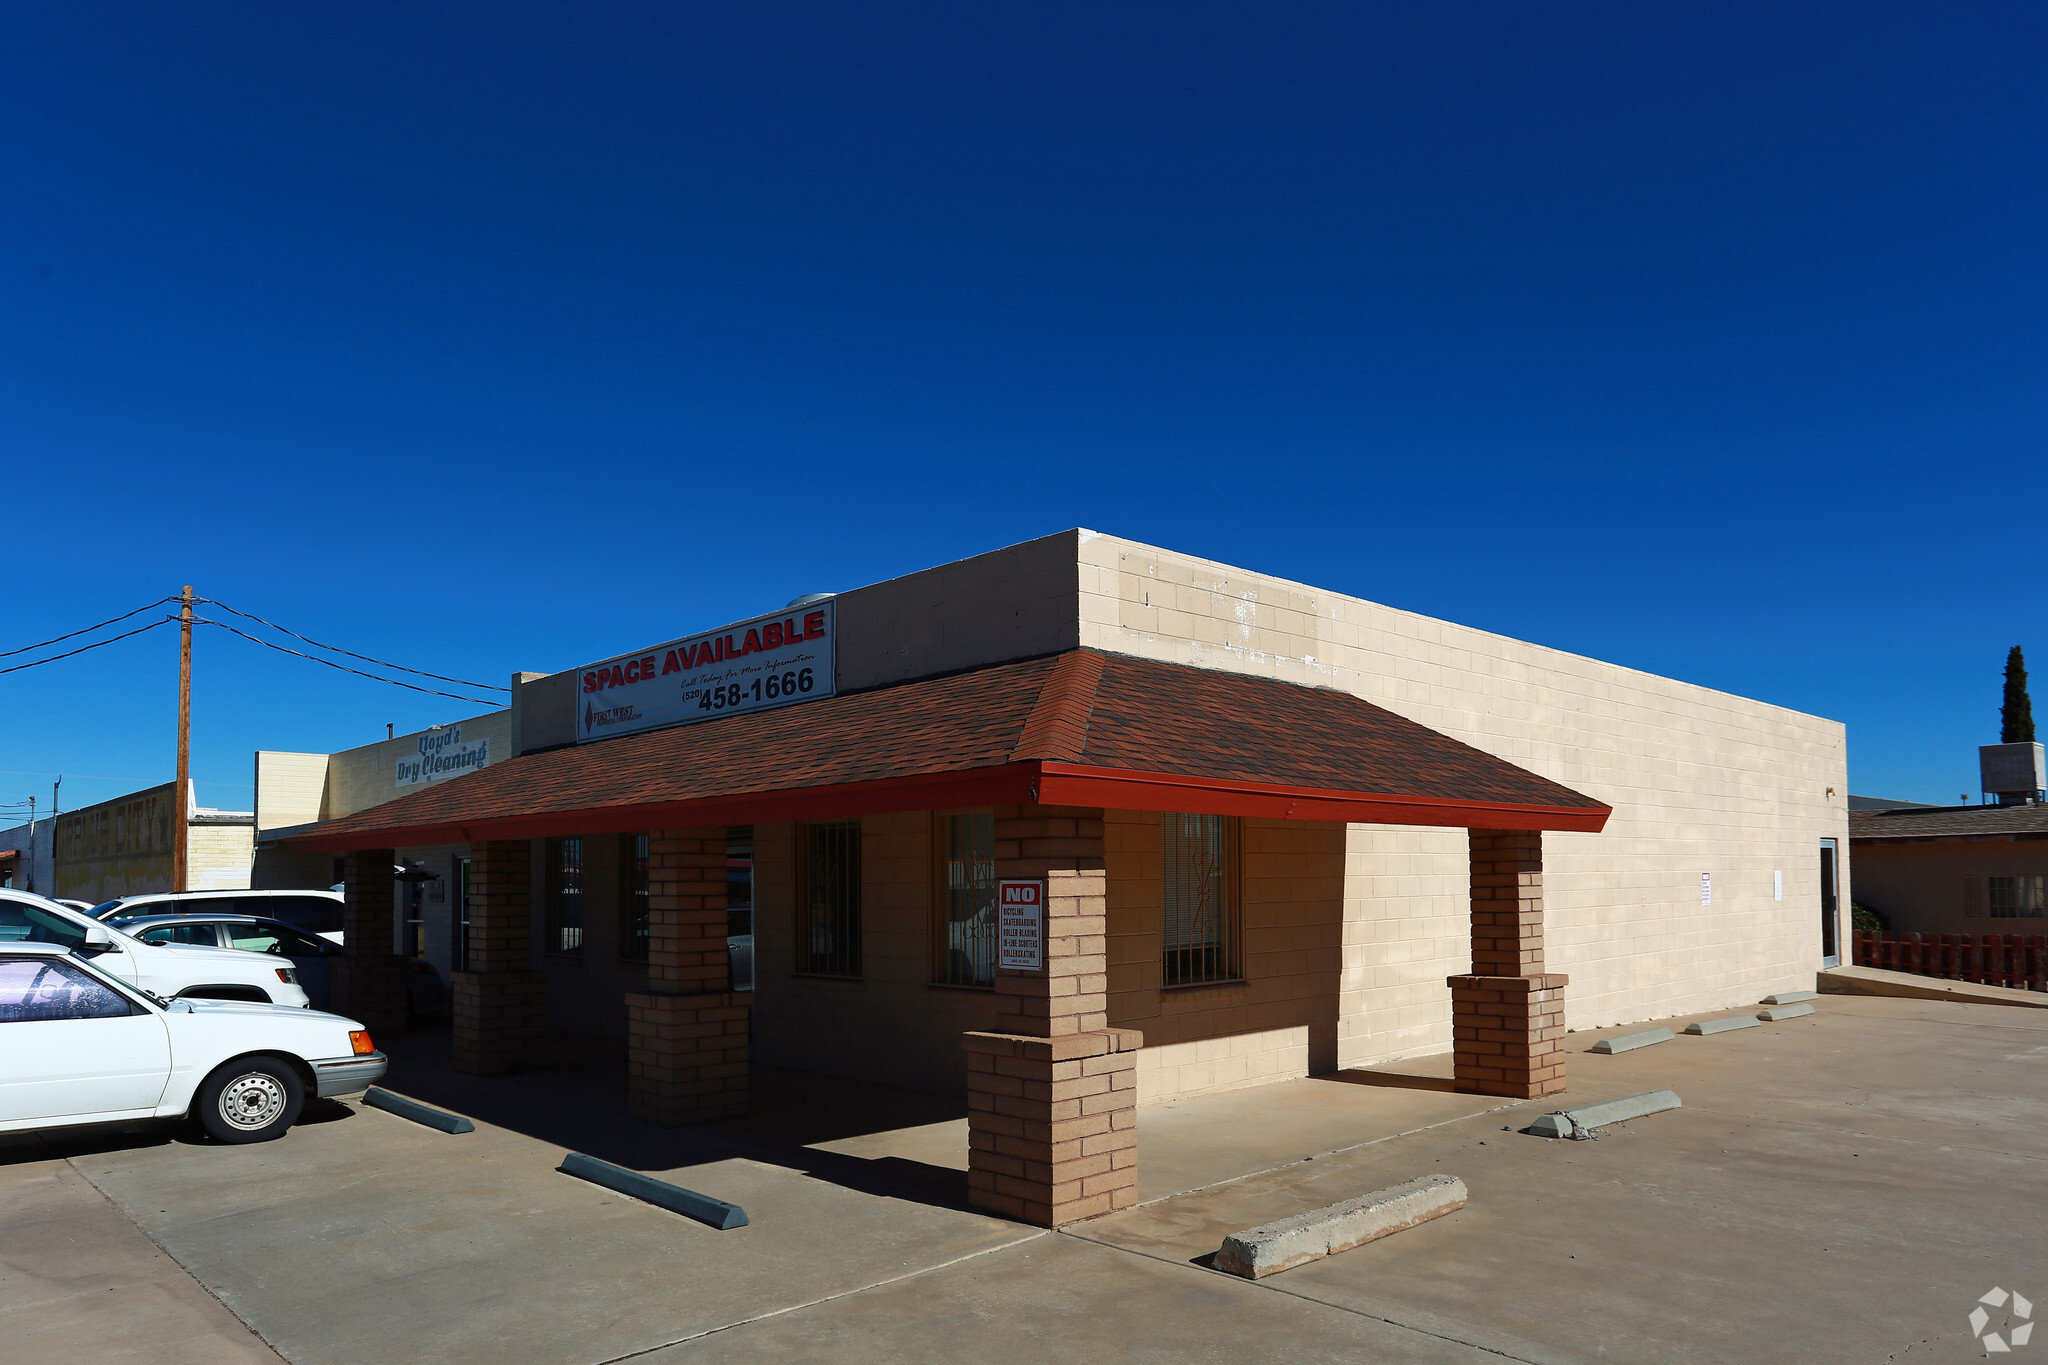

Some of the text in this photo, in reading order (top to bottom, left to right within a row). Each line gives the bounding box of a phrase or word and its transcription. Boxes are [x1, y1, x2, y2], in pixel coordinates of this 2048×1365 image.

[583, 610, 825, 694] SPACE AVAILABLE
[681, 653, 816, 689] Call Today For More Information
[682, 667, 814, 712] (520) 458-1666
[593, 705, 634, 722] FIRST WEST
[418, 725, 460, 756] Lloyd's
[397, 740, 487, 783] Dry Cleaning
[1005, 887, 1036, 903] NO
[1003, 907, 1024, 916] BICYCLING
[1003, 918, 1037, 927] SKATEBOARDING
[1003, 928, 1037, 938] ROLLER BLADING
[1003, 938, 1038, 949] IN-LINE SCOOTERS
[1003, 949, 1036, 959] ROLLERSKATING
